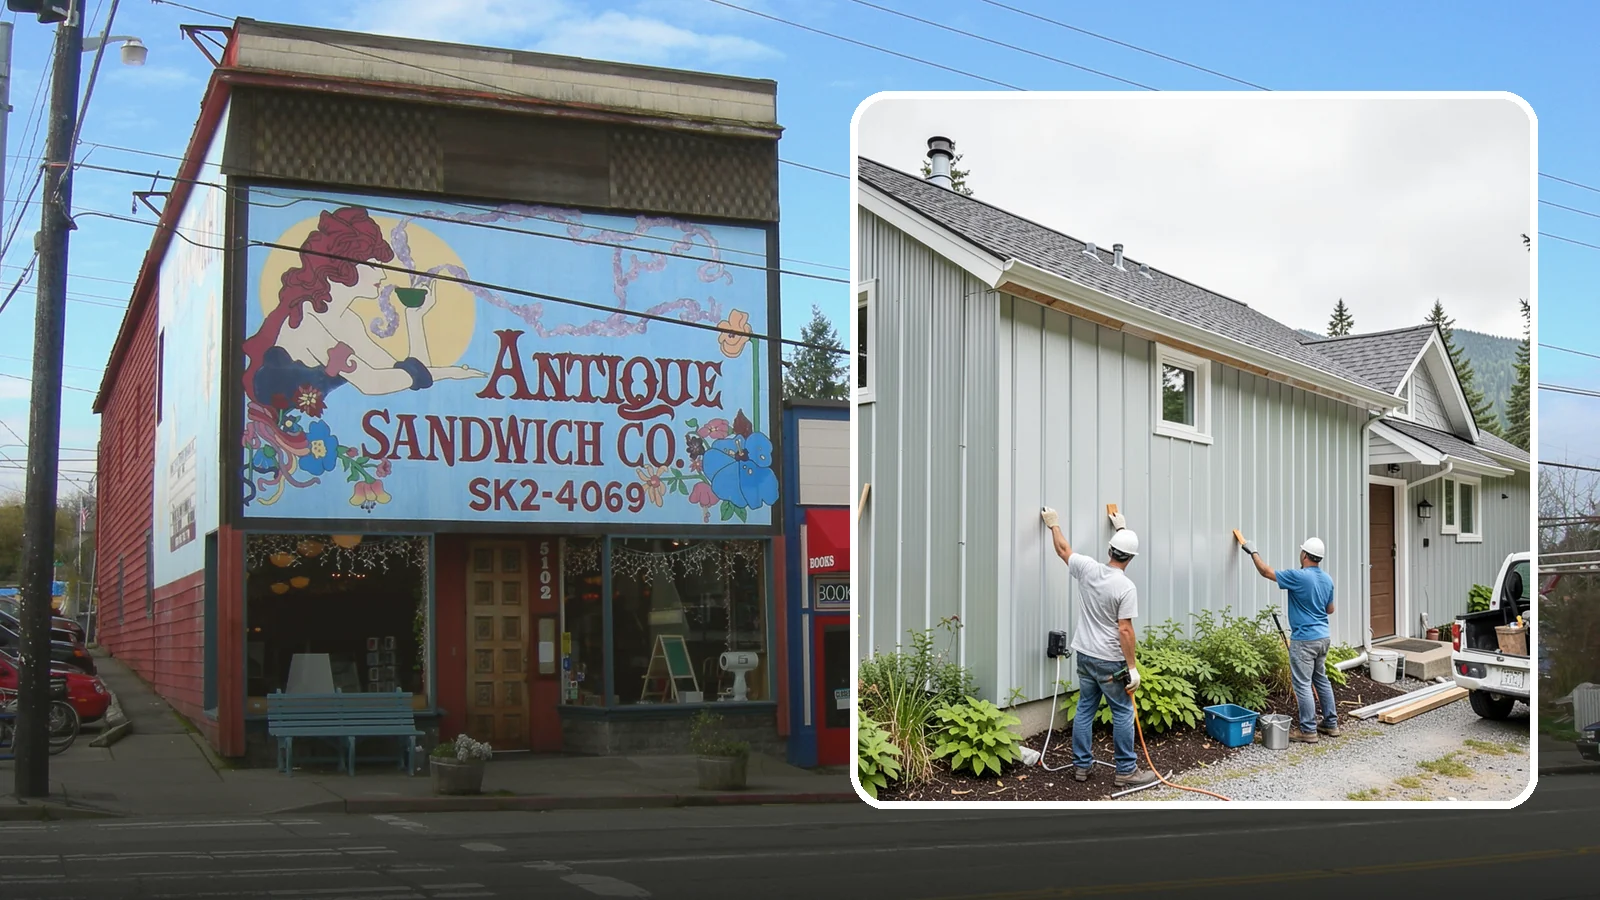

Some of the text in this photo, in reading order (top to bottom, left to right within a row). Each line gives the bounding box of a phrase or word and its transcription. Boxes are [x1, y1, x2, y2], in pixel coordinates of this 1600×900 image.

[361, 408, 685, 469] SANDWICH CO.
[468, 477, 646, 512] SK2-4069
[540, 541, 551, 600] 5102
[809, 555, 835, 569] BOOKS
